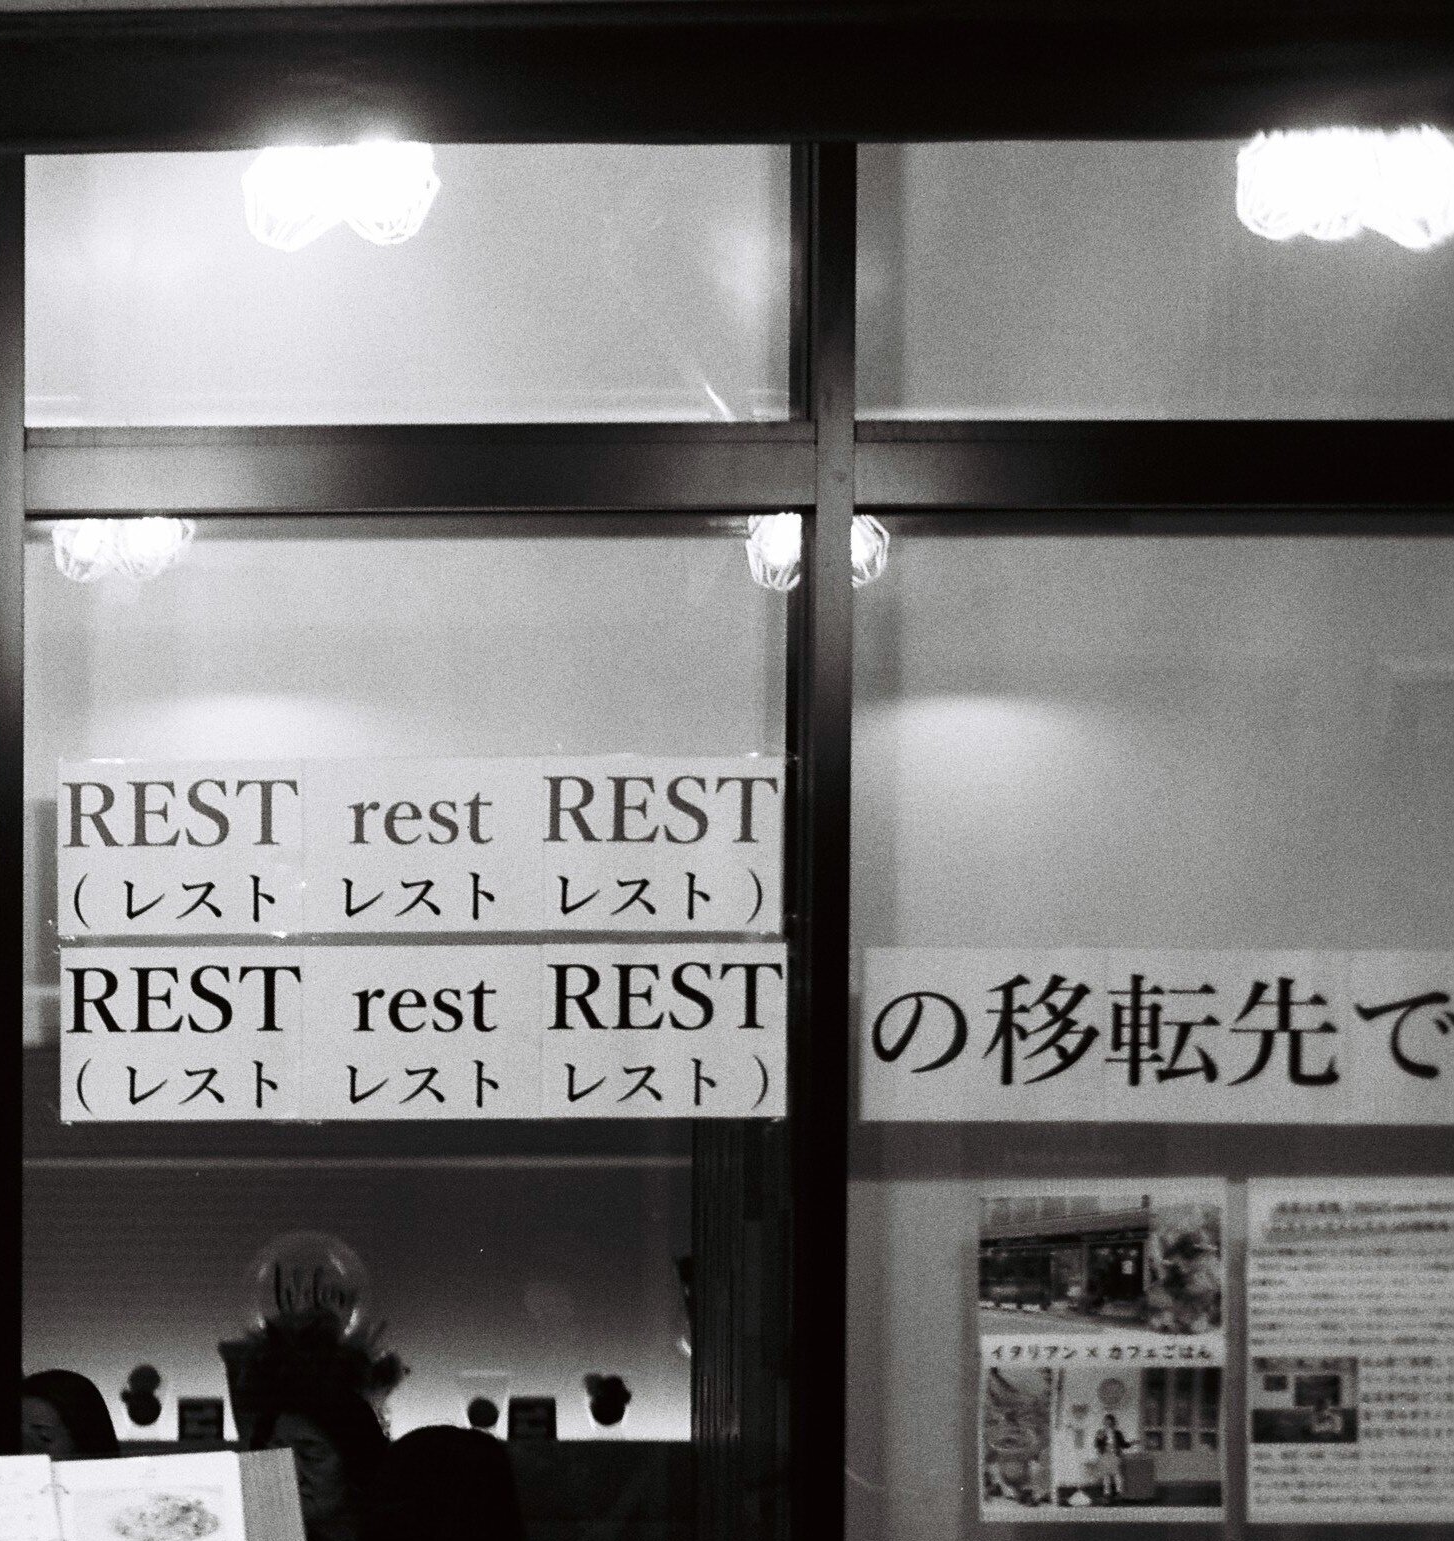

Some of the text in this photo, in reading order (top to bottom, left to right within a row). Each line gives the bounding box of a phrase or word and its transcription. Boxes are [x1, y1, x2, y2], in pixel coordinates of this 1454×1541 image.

[61, 774, 780, 848] REST rest REST
[341, 870, 496, 922] レスト
[64, 960, 784, 1034] REST rest REST
[870, 973, 1454, 1087] の移転先で
[346, 1059, 500, 1110] レスト
[992, 1344, 1078, 1361] イタリアン
[1108, 1343, 1211, 1361] カフェごはん
